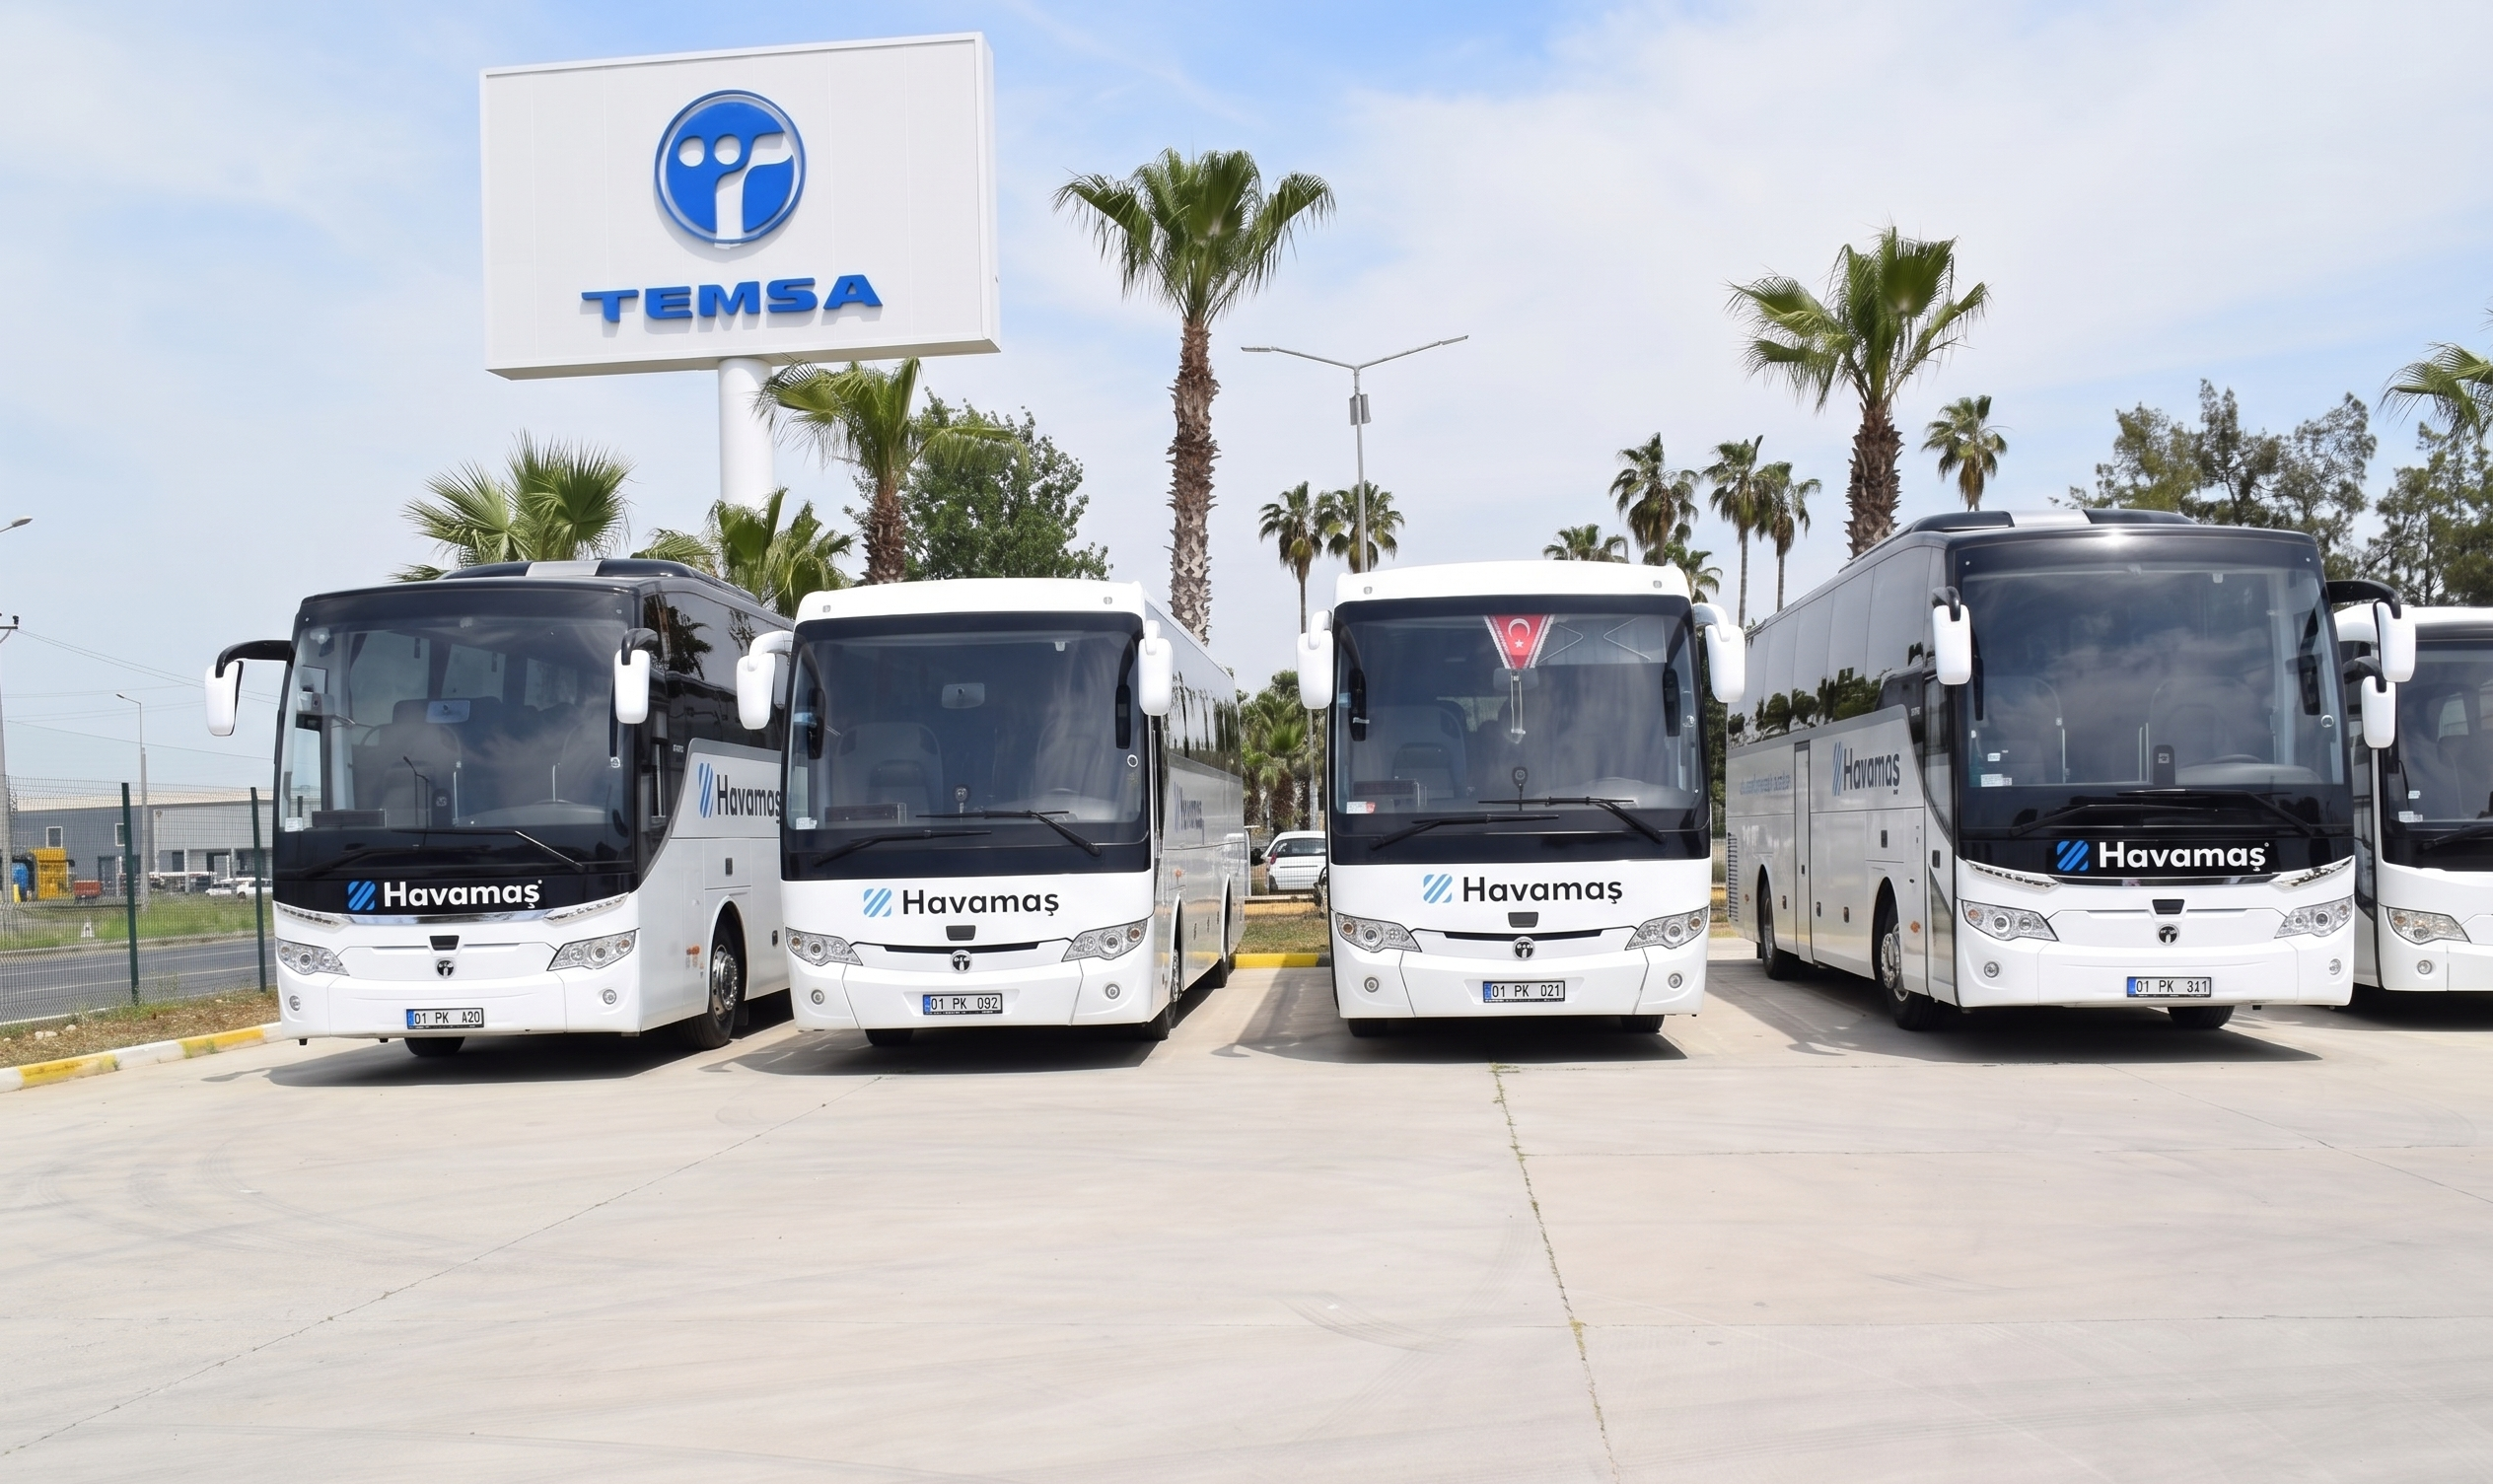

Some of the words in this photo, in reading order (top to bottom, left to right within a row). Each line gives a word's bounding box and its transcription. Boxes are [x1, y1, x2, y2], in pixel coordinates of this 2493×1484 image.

[581, 274, 883, 322] TEMSA
[2099, 841, 2266, 872] Havamaş
[384, 881, 540, 909] Havamaş
[902, 888, 1060, 916] Havamaş
[1462, 876, 1623, 905] Havamaş
[1492, 985, 1505, 998] 01
[1514, 984, 1530, 997] PK
[1540, 984, 1560, 997] 021
[2136, 980, 2149, 993] 01
[2159, 979, 2174, 993] PK
[930, 997, 944, 1010] 01
[952, 997, 967, 1010] PK
[976, 996, 998, 1010] 092
[414, 1012, 427, 1025] 01
[434, 1011, 450, 1024] PK
[462, 1010, 480, 1024] A20
